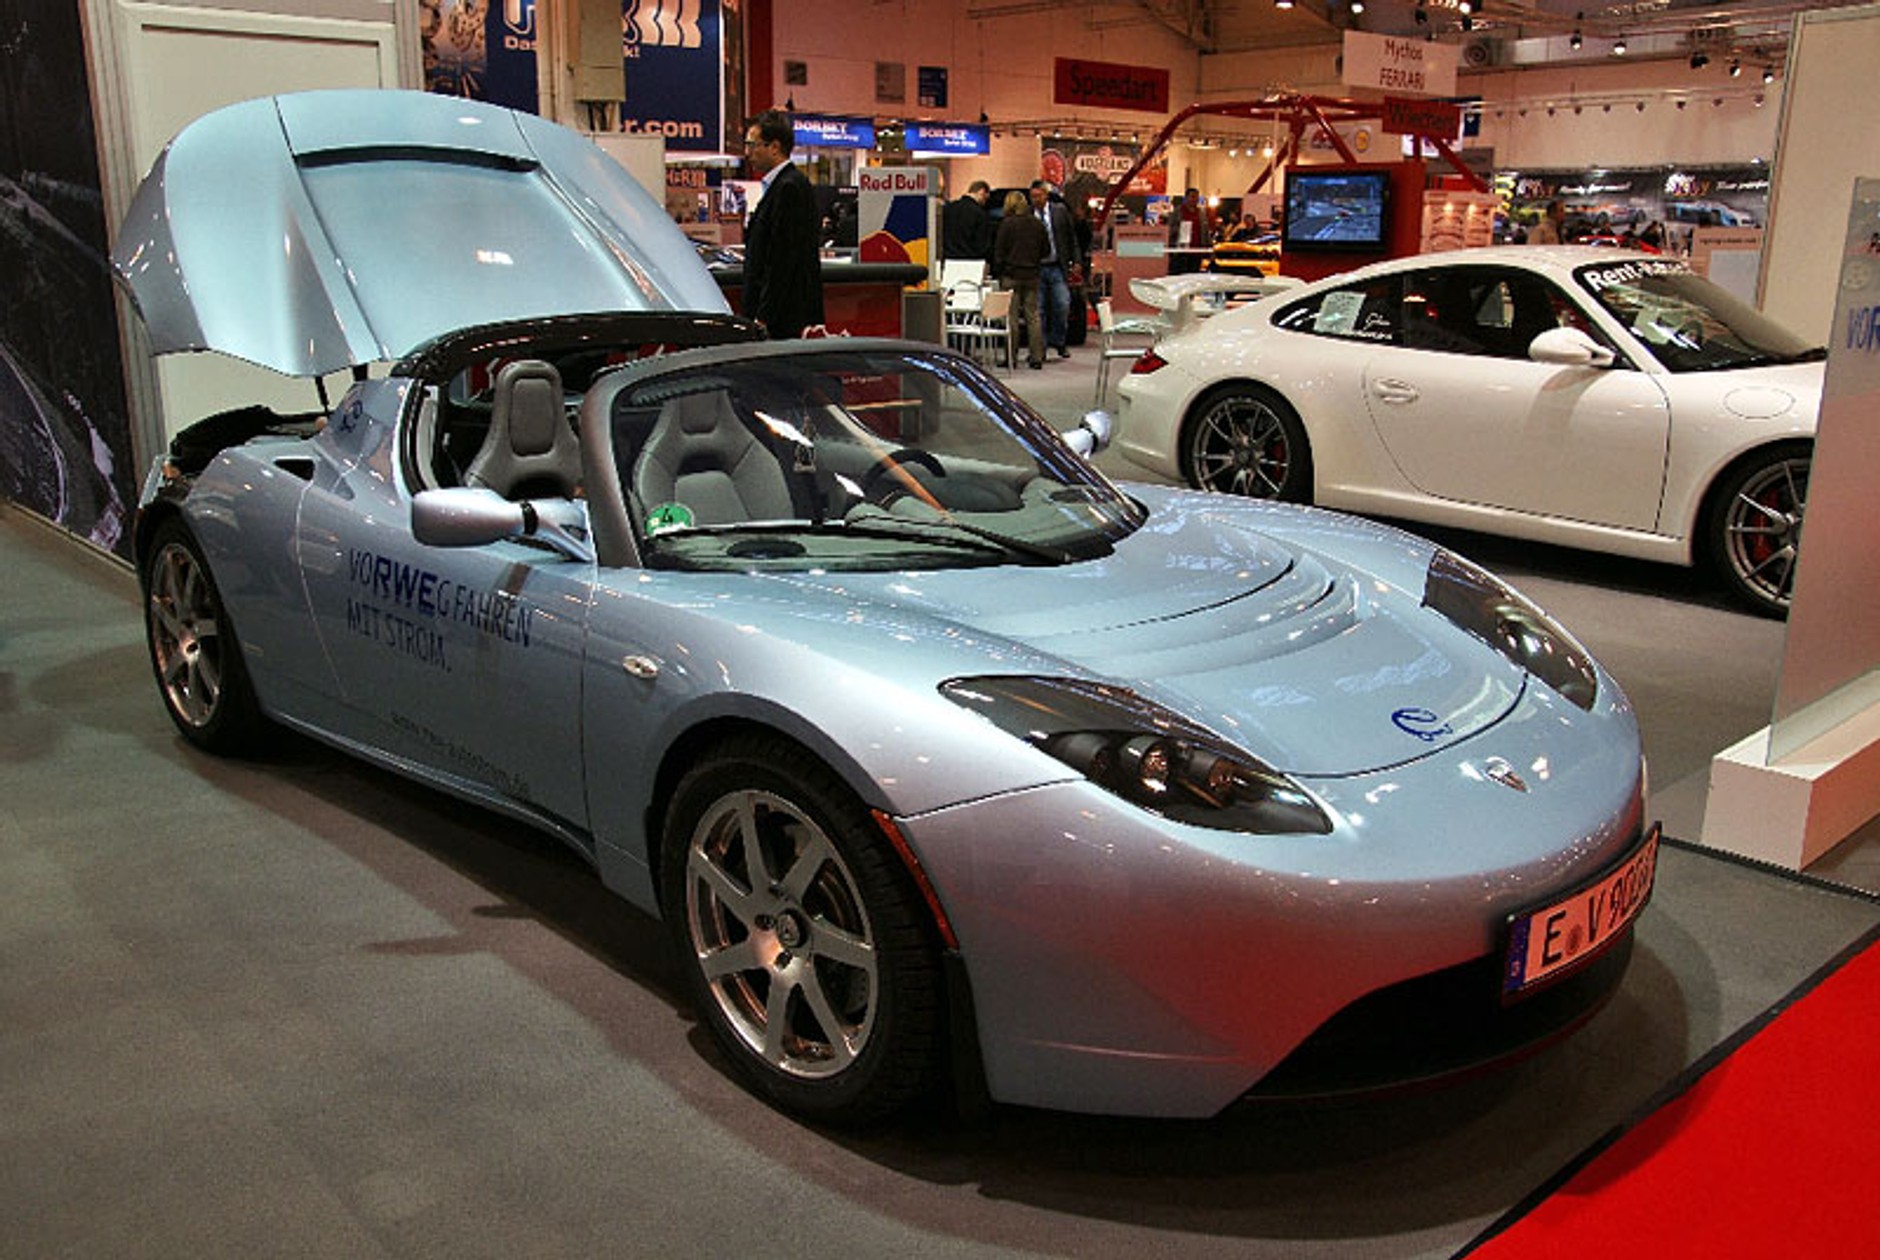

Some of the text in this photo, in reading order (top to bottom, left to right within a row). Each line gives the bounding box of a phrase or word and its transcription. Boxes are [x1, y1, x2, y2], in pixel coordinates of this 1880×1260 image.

[1384, 39, 1423, 63] Mythos
[1379, 67, 1425, 91] FERRARI
[859, 173, 927, 191] Red Bull
[1542, 910, 1567, 968] E
